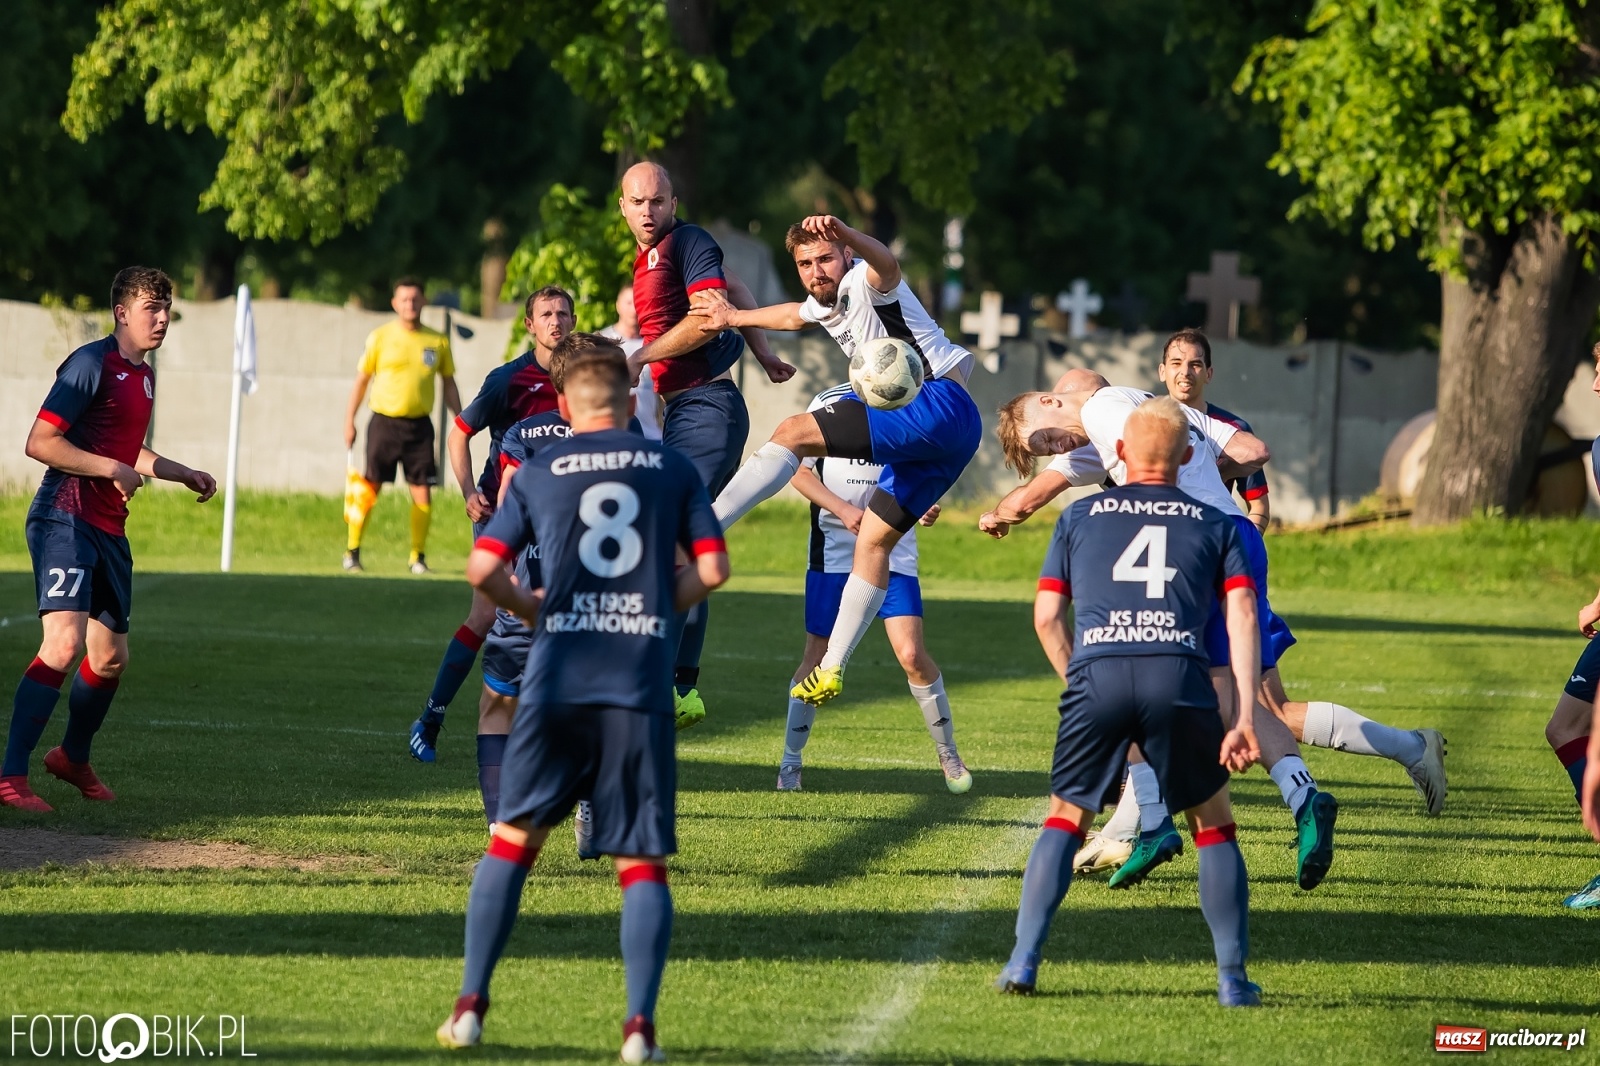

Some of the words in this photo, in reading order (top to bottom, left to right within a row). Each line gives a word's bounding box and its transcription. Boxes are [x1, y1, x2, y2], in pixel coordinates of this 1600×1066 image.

[551, 450, 664, 476] CZEREPAK
[1089, 498, 1204, 521] ADAMCZYK
[579, 481, 644, 579] 8
[1112, 524, 1178, 599] 4
[47, 567, 85, 598] 27
[572, 592, 597, 613] KS
[600, 592, 644, 614] 1905
[1109, 610, 1132, 627] KS
[1136, 610, 1176, 627] 1905
[1083, 625, 1197, 650] KRZANOWICE
